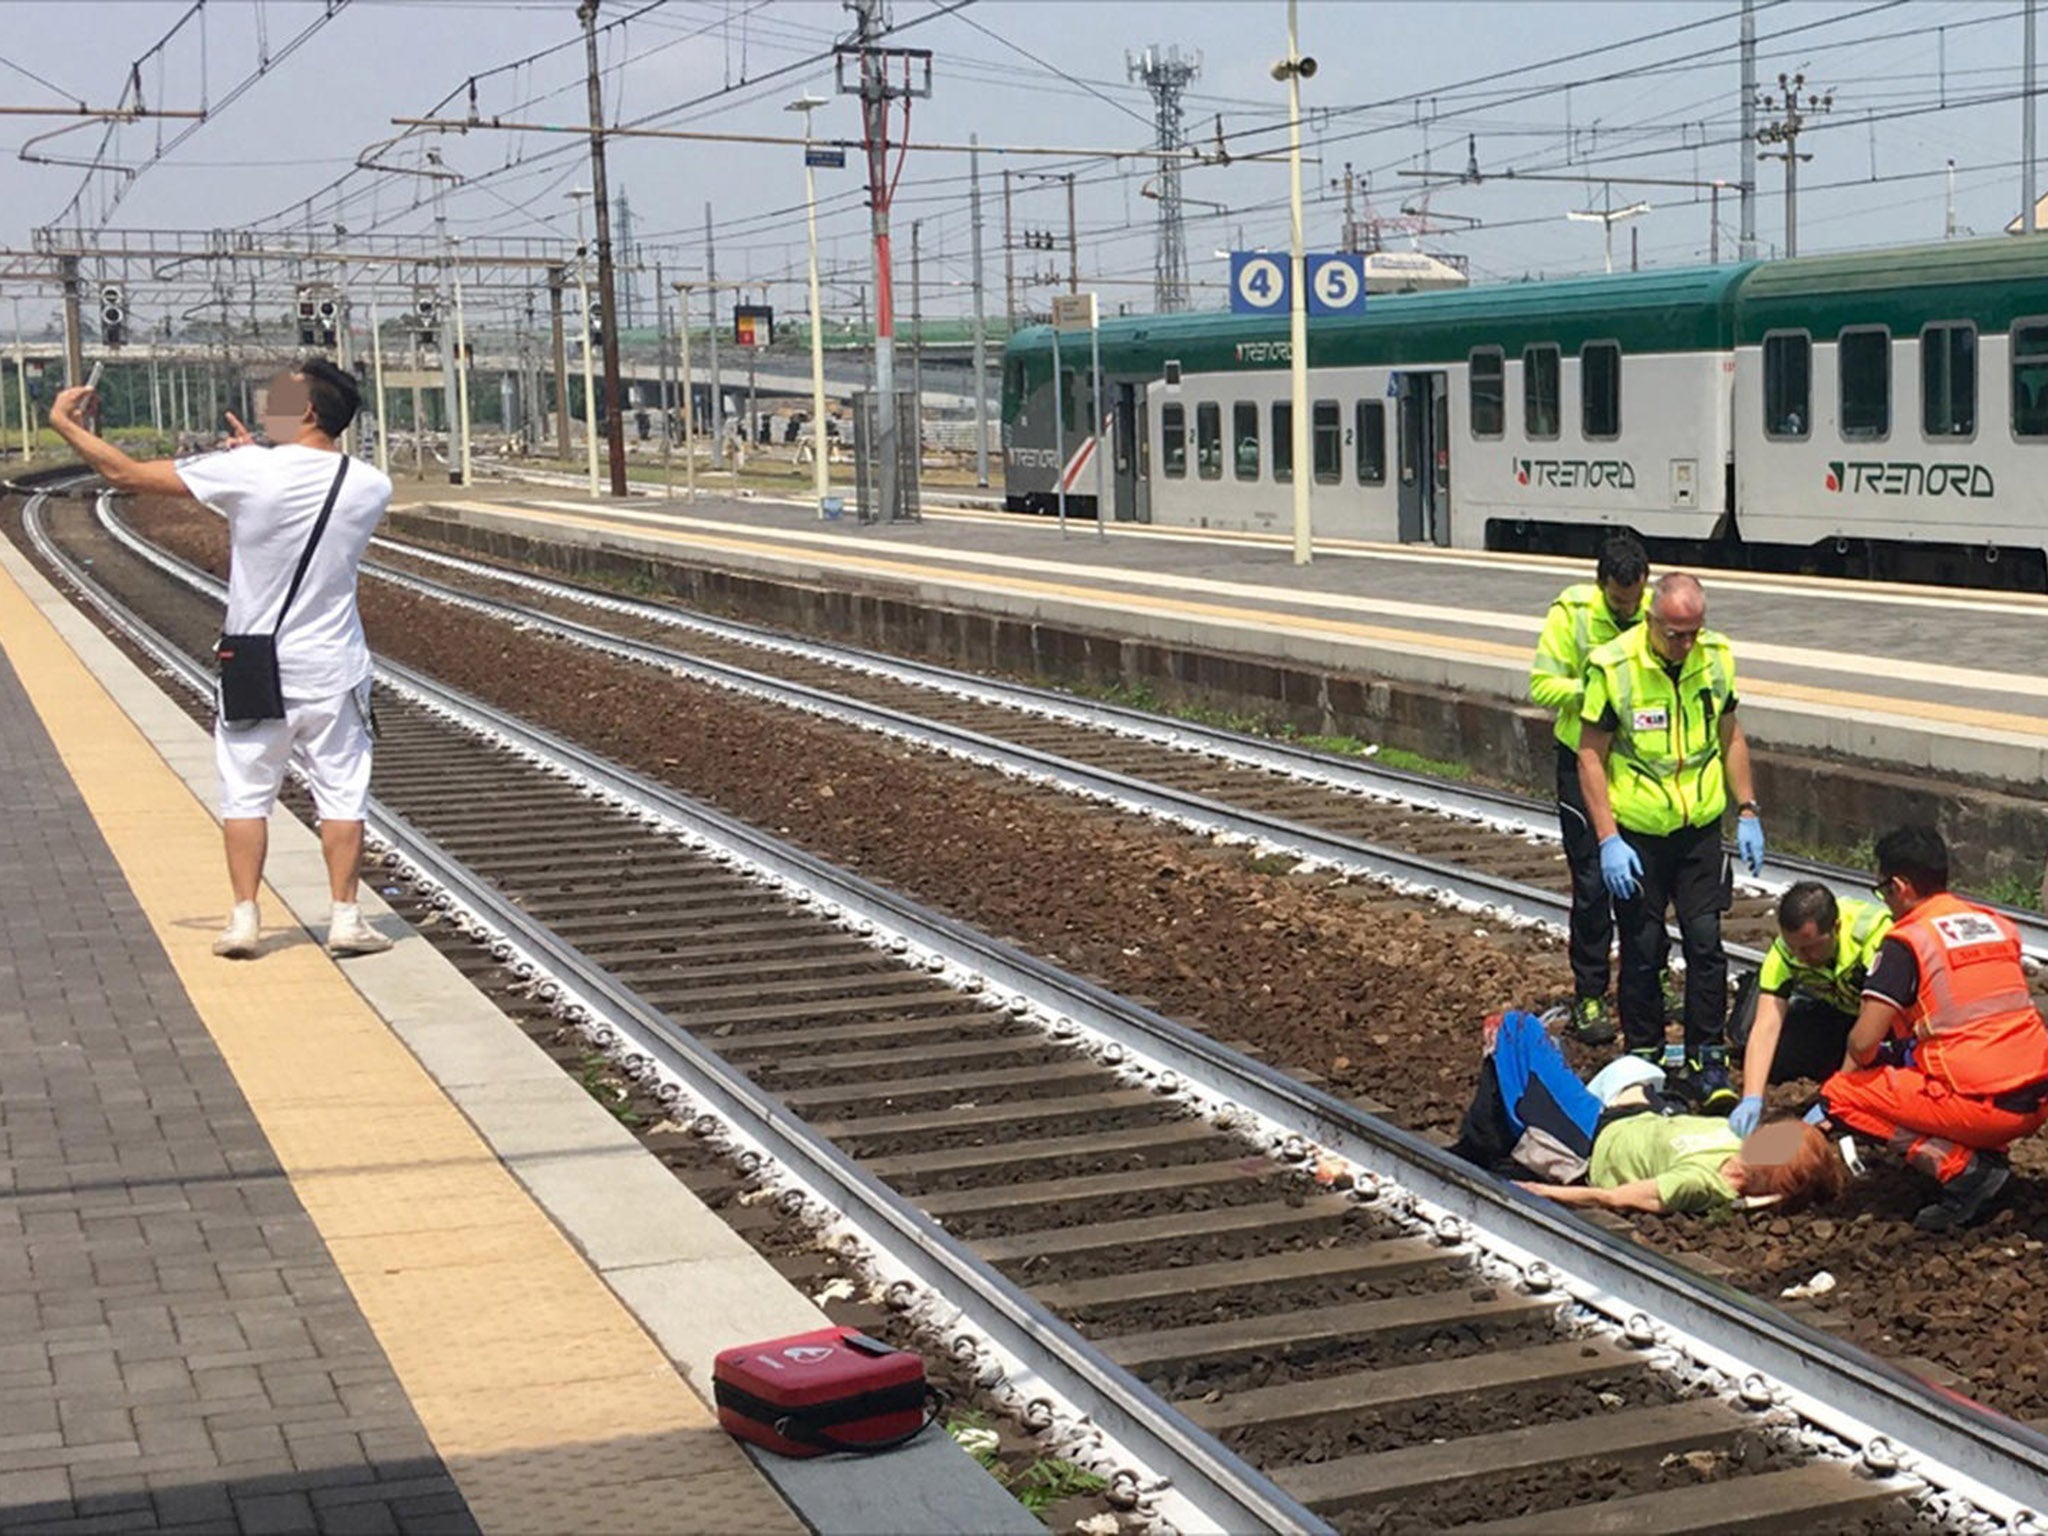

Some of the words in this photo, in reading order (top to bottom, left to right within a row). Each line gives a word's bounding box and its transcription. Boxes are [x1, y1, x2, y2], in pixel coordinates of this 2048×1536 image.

[1248, 268, 1271, 298] 4
[1327, 269, 1347, 300] 5
[1345, 427, 1353, 446] 2
[1014, 447, 1059, 468] TRENOR
[1534, 460, 1636, 488] TRENORD
[1847, 462, 1994, 497] TRENORD
